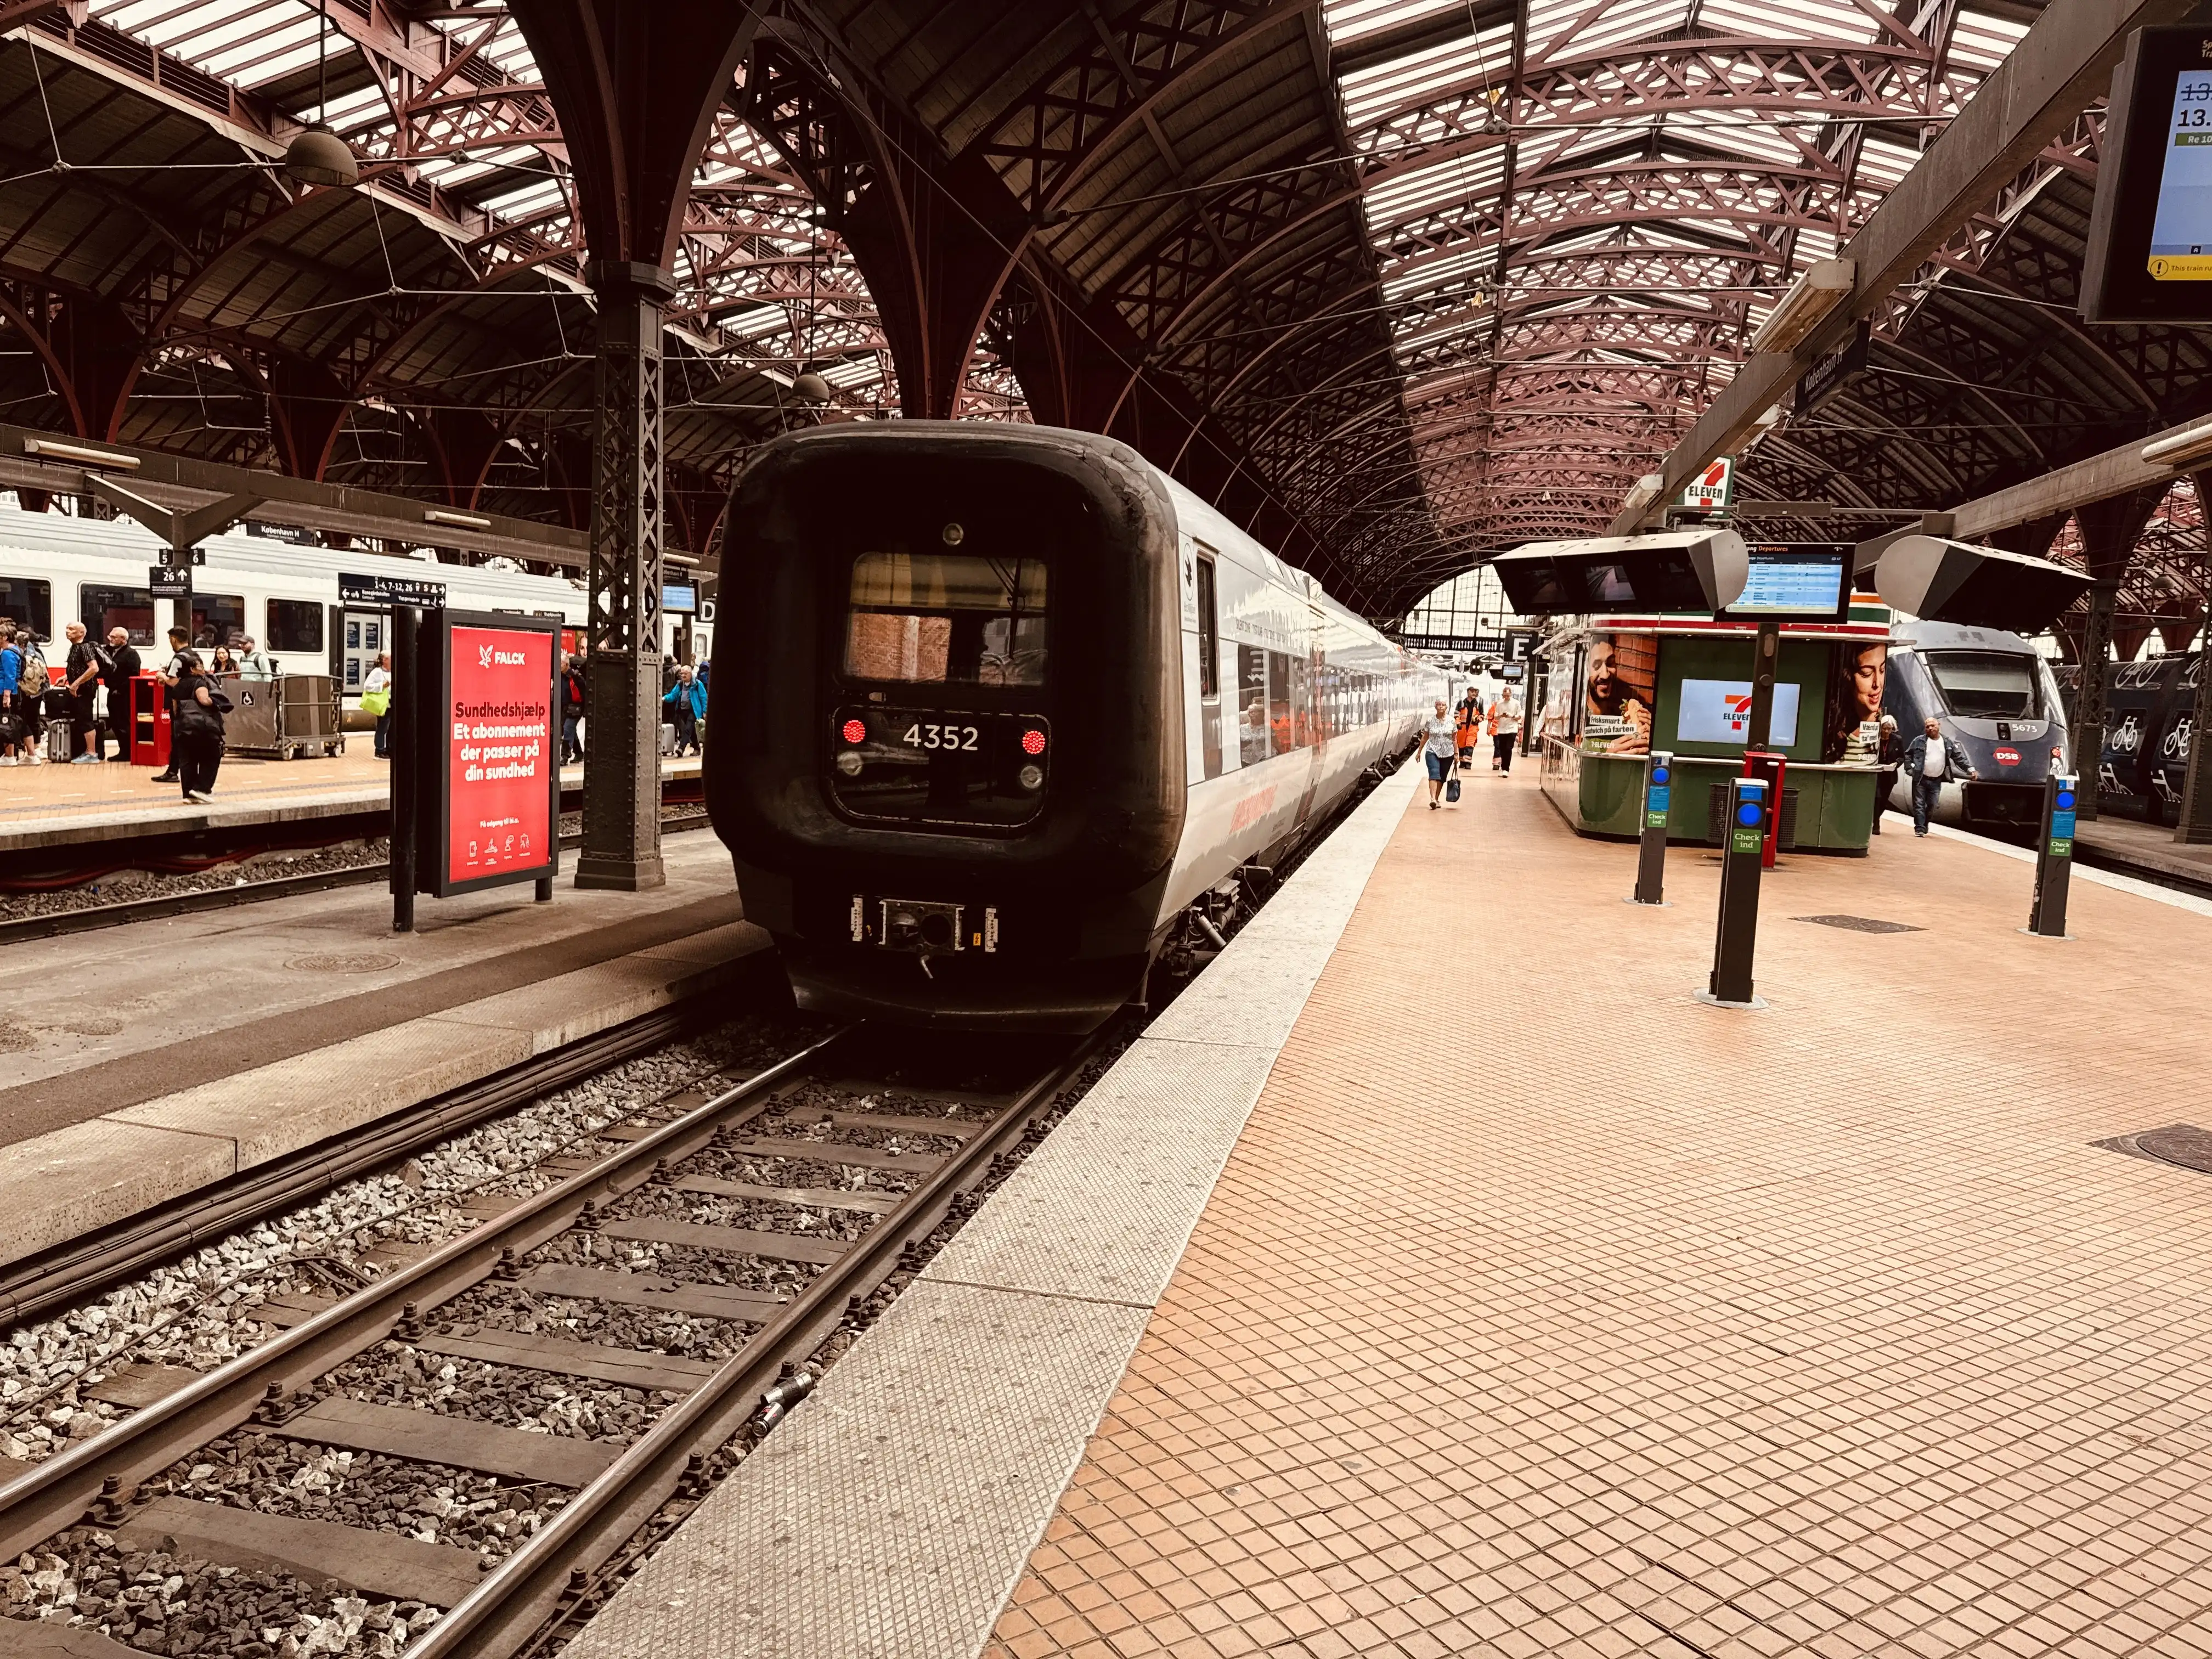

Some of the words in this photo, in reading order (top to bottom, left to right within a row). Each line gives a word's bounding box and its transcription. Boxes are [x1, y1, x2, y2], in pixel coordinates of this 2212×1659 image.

[1805, 352, 1837, 394] København
[1837, 342, 1844, 365] H
[261, 525, 294, 537] København
[162, 555, 168, 563] 5
[193, 555, 199, 563] 6
[163, 572, 174, 582] 26
[405, 584, 413, 592] 26
[701, 601, 715, 622] D
[1513, 637, 1530, 661] E
[495, 651, 525, 665] FALCK
[455, 702, 545, 720] Sundhedshjælp
[1590, 716, 1620, 724] Frisksmurt
[454, 723, 470, 740] Et
[472, 722, 546, 739] abonnement
[1604, 726, 1611, 734] på
[2012, 724, 2038, 732] 5673
[903, 724, 978, 751] 4352
[460, 744, 481, 761] der
[483, 744, 523, 764] passer
[524, 738, 540, 761] på
[465, 764, 484, 782] din
[486, 760, 534, 779] sundhed
